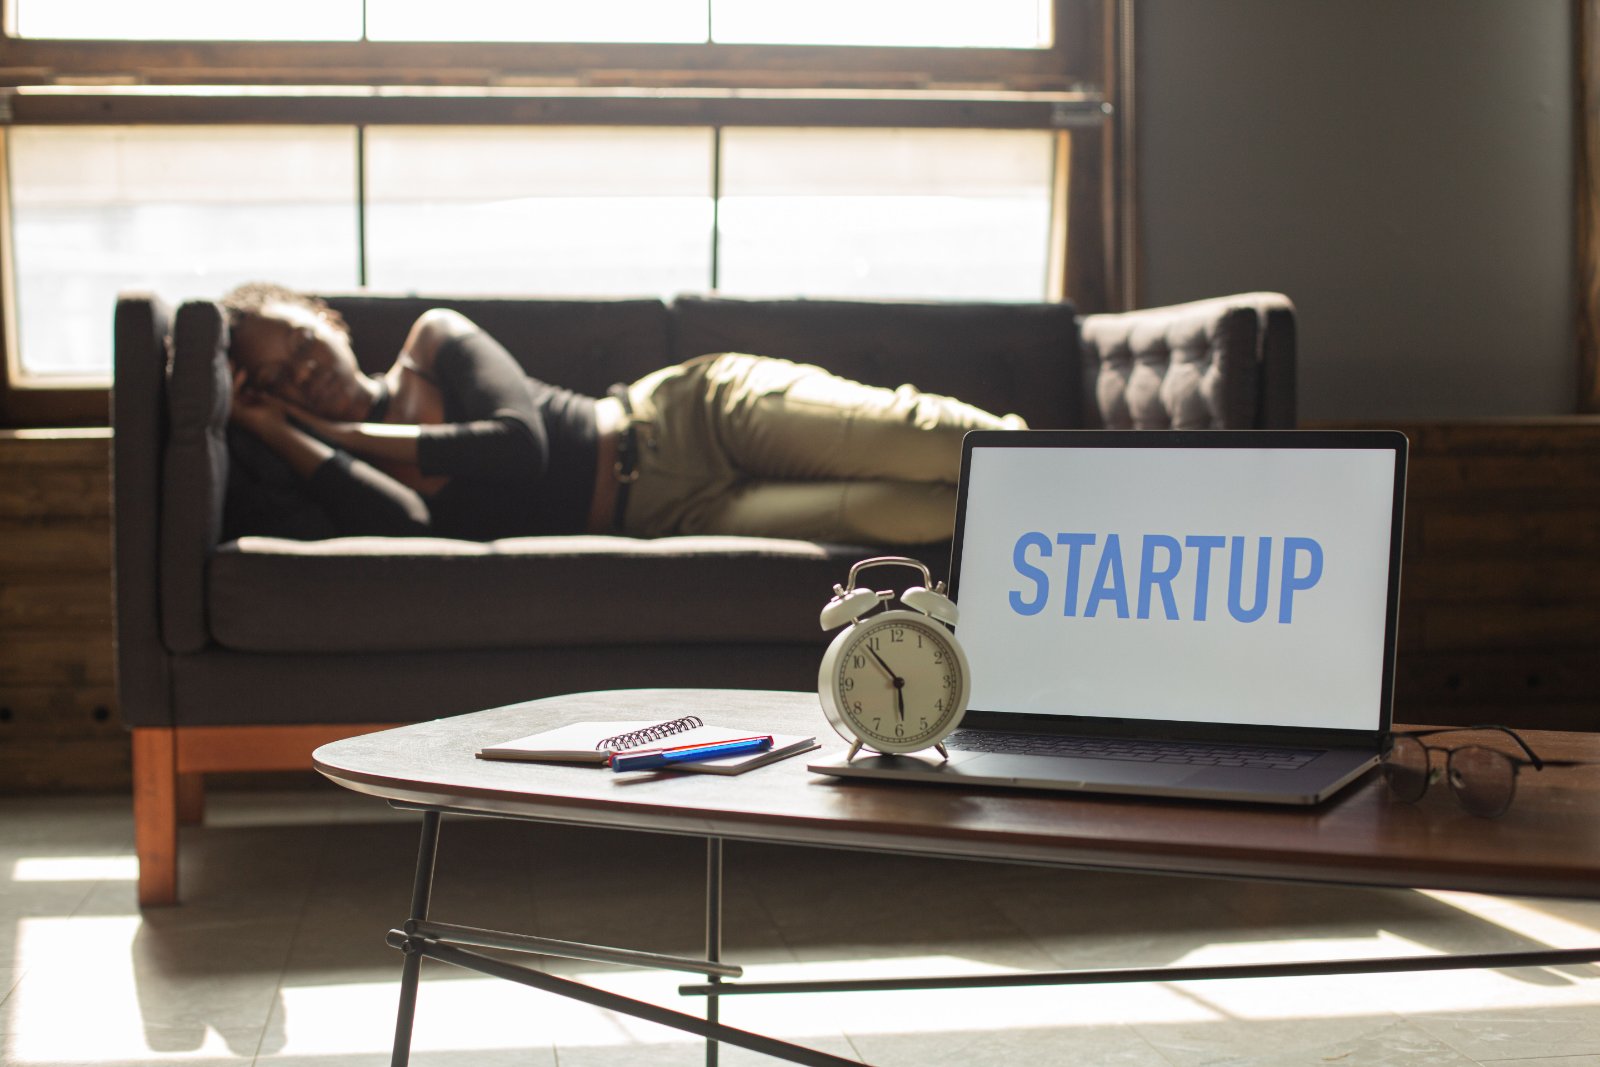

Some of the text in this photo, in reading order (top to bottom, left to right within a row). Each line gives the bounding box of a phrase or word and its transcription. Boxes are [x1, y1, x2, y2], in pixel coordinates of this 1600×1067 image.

[1008, 531, 1324, 624] STARTUP
[890, 629, 904, 642] 12
[917, 635, 923, 648] 1
[869, 637, 880, 651] 11
[853, 655, 865, 669] 10
[934, 651, 943, 664] 2
[844, 678, 854, 691] 9
[942, 675, 951, 689] 3
[853, 701, 862, 715] 8
[934, 698, 943, 711] 4
[872, 717, 881, 731] 7
[920, 717, 928, 730] 5
[895, 724, 904, 737] 6
